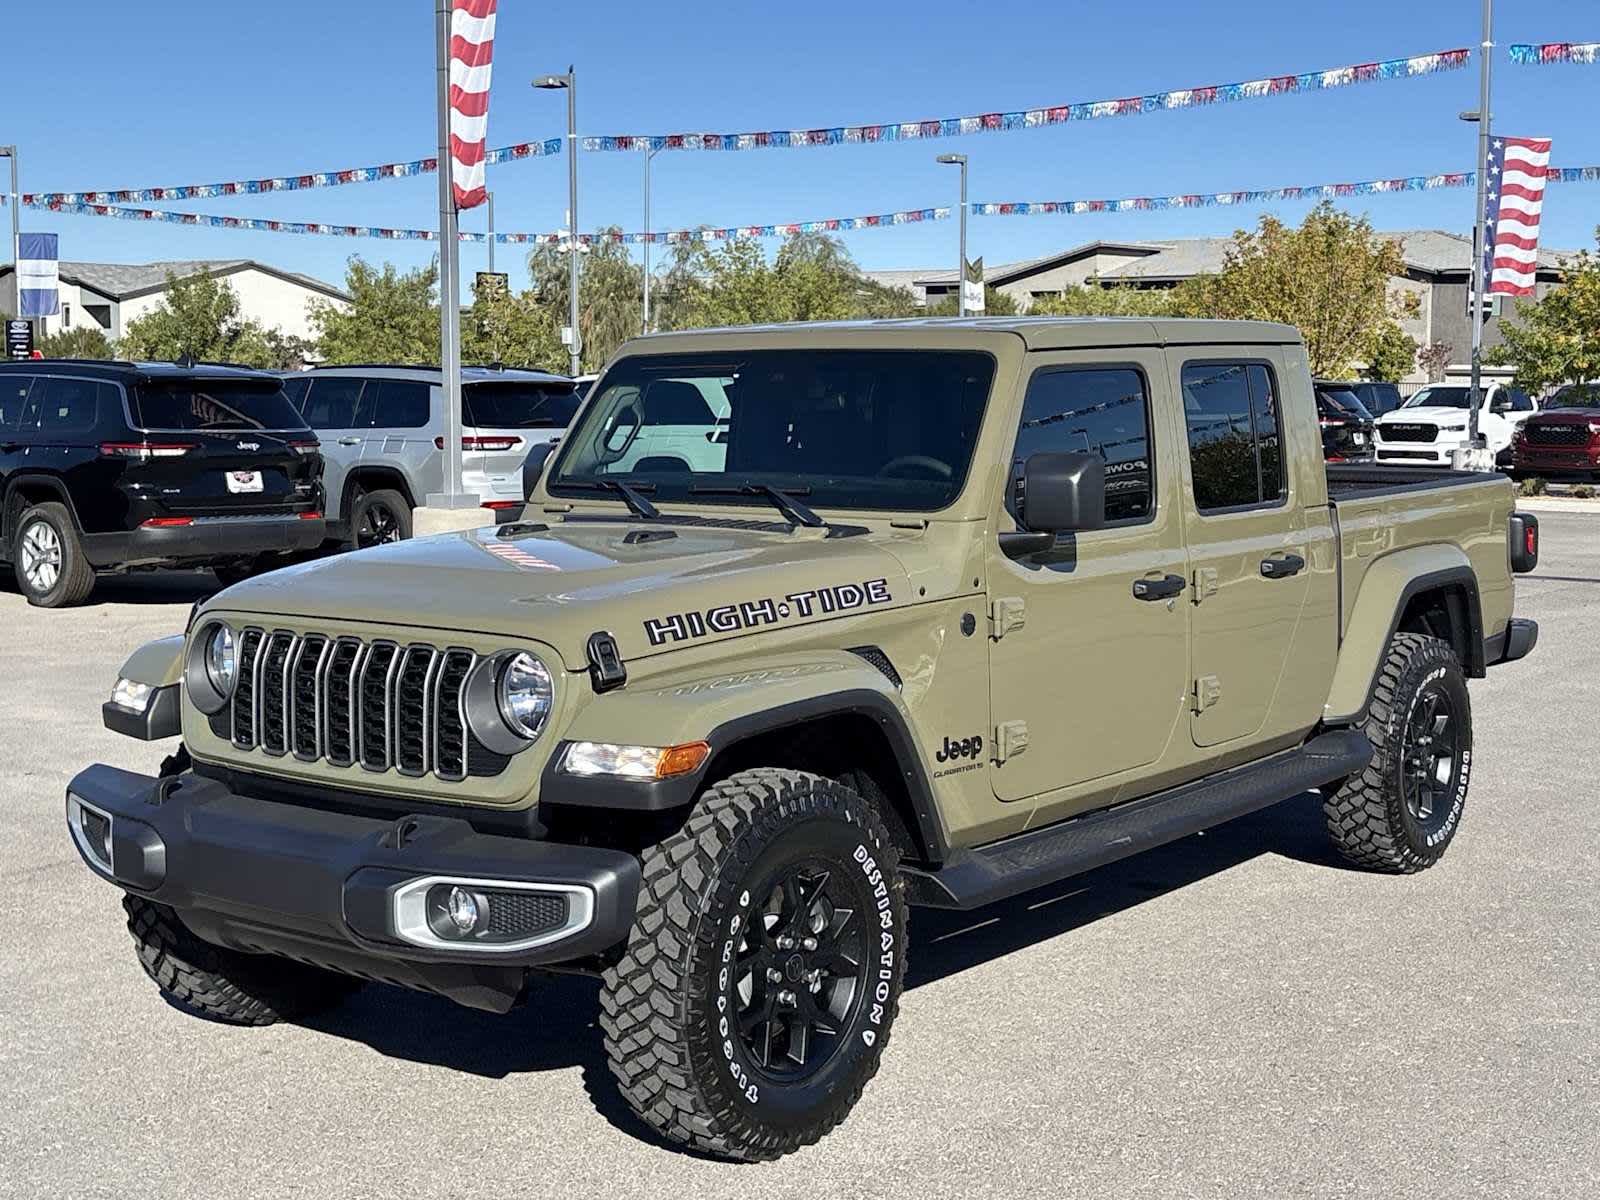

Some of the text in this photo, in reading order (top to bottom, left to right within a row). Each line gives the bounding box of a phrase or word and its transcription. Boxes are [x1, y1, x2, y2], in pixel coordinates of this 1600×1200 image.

[236, 441, 260, 451] Jeep
[643, 578, 892, 646] HIGH TIDE
[935, 735, 983, 763] Jeep
[933, 764, 976, 778] GLADIATOR
[853, 844, 894, 1025] DESTINATION
